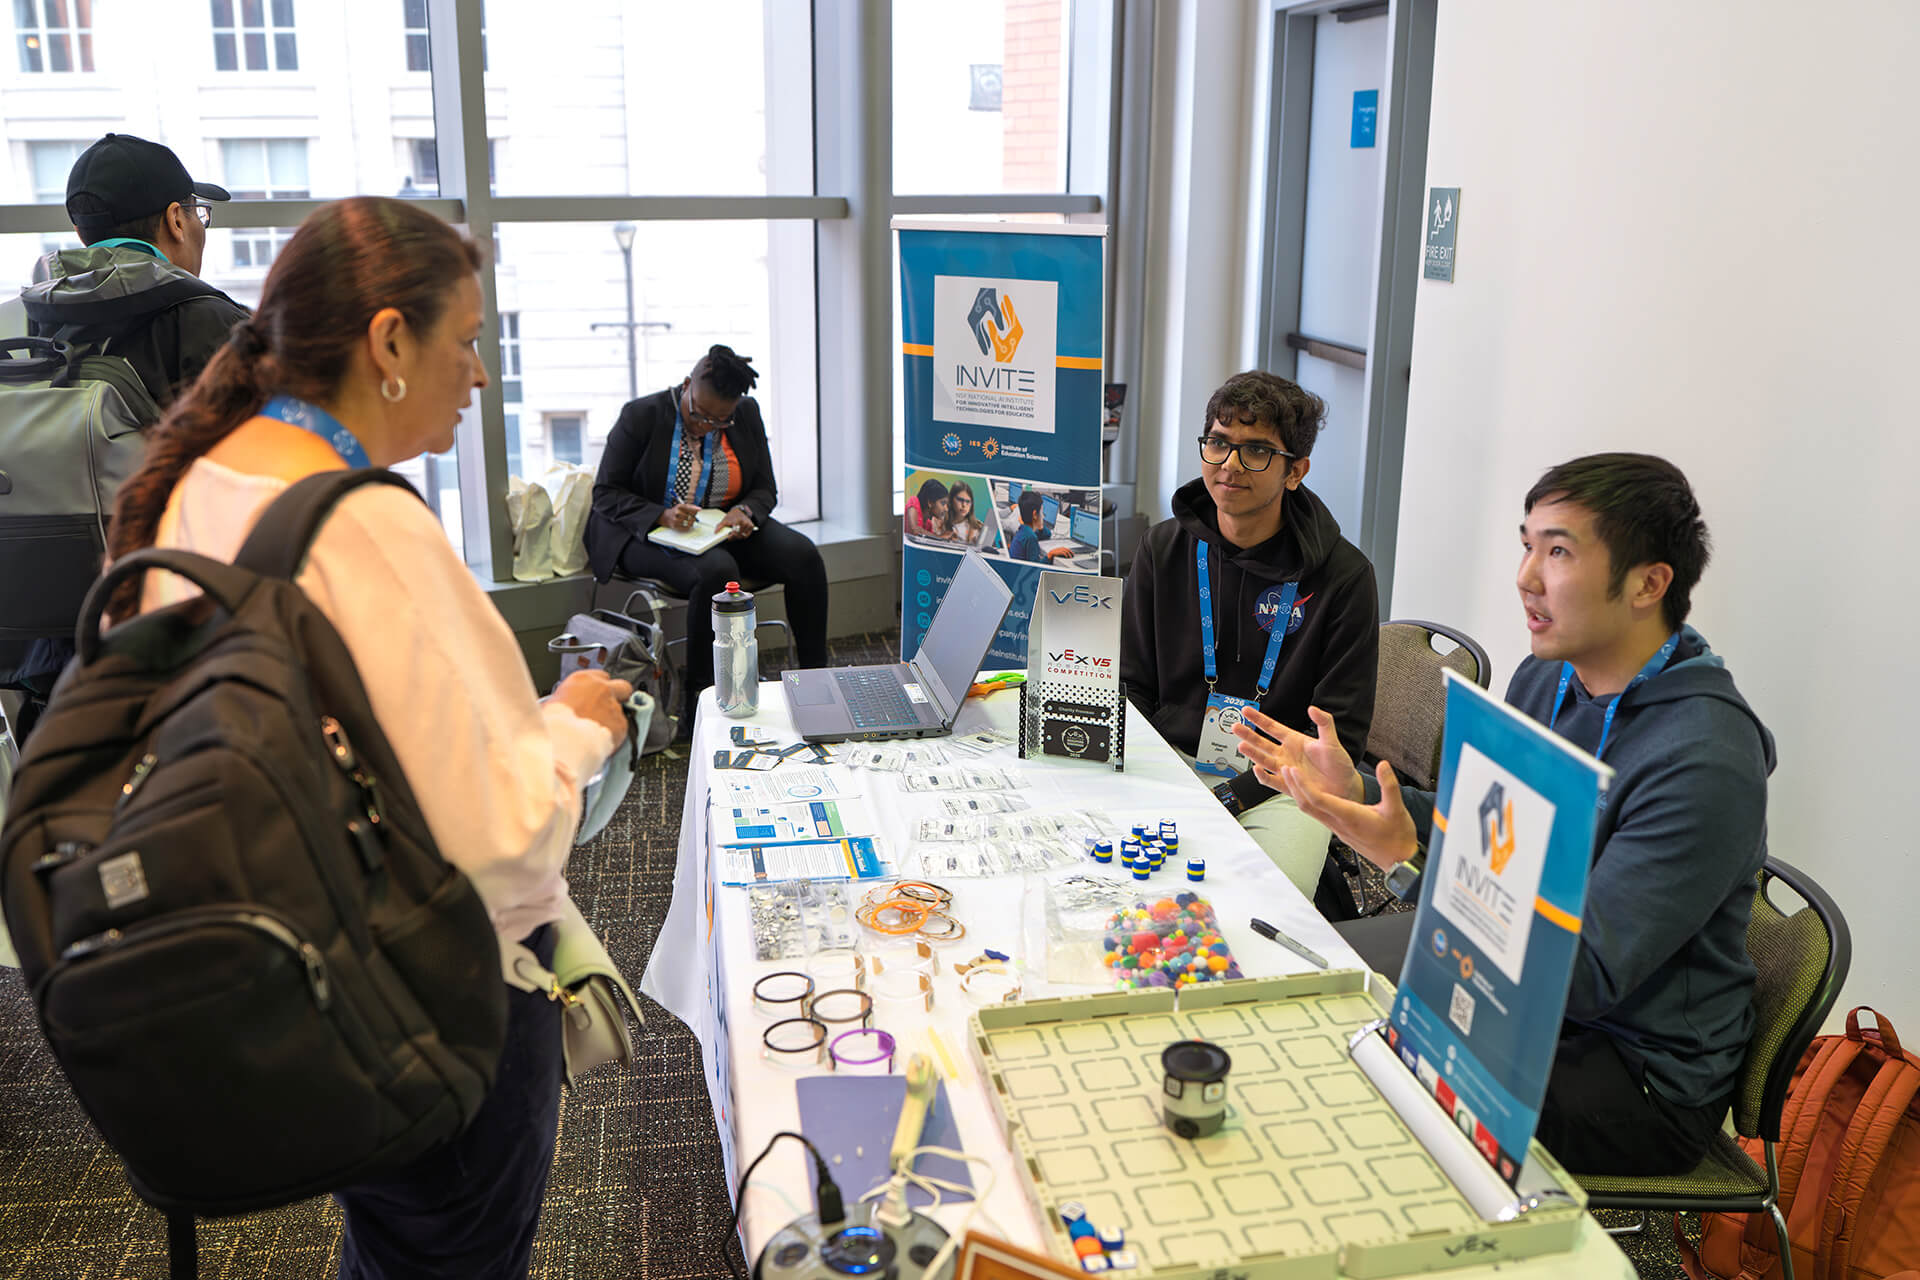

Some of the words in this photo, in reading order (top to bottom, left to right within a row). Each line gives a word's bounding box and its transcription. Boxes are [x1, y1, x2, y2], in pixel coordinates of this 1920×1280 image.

[956, 365, 1035, 392] INVITE
[968, 394, 997, 402] NATIONAL
[956, 406, 993, 414] TECHNOLOGIES
[1001, 404, 1034, 412] INTELLIGENT
[1001, 443, 1021, 452] Institute
[1001, 449, 1025, 458] Education
[1026, 453, 1049, 462] Sciences
[1049, 585, 1112, 609] VEX
[1259, 603, 1302, 617] NAA
[1048, 649, 1089, 665] VEX
[1092, 656, 1112, 667] V5
[1047, 667, 1112, 679] COMPETITION
[1456, 855, 1517, 925] INVITE
